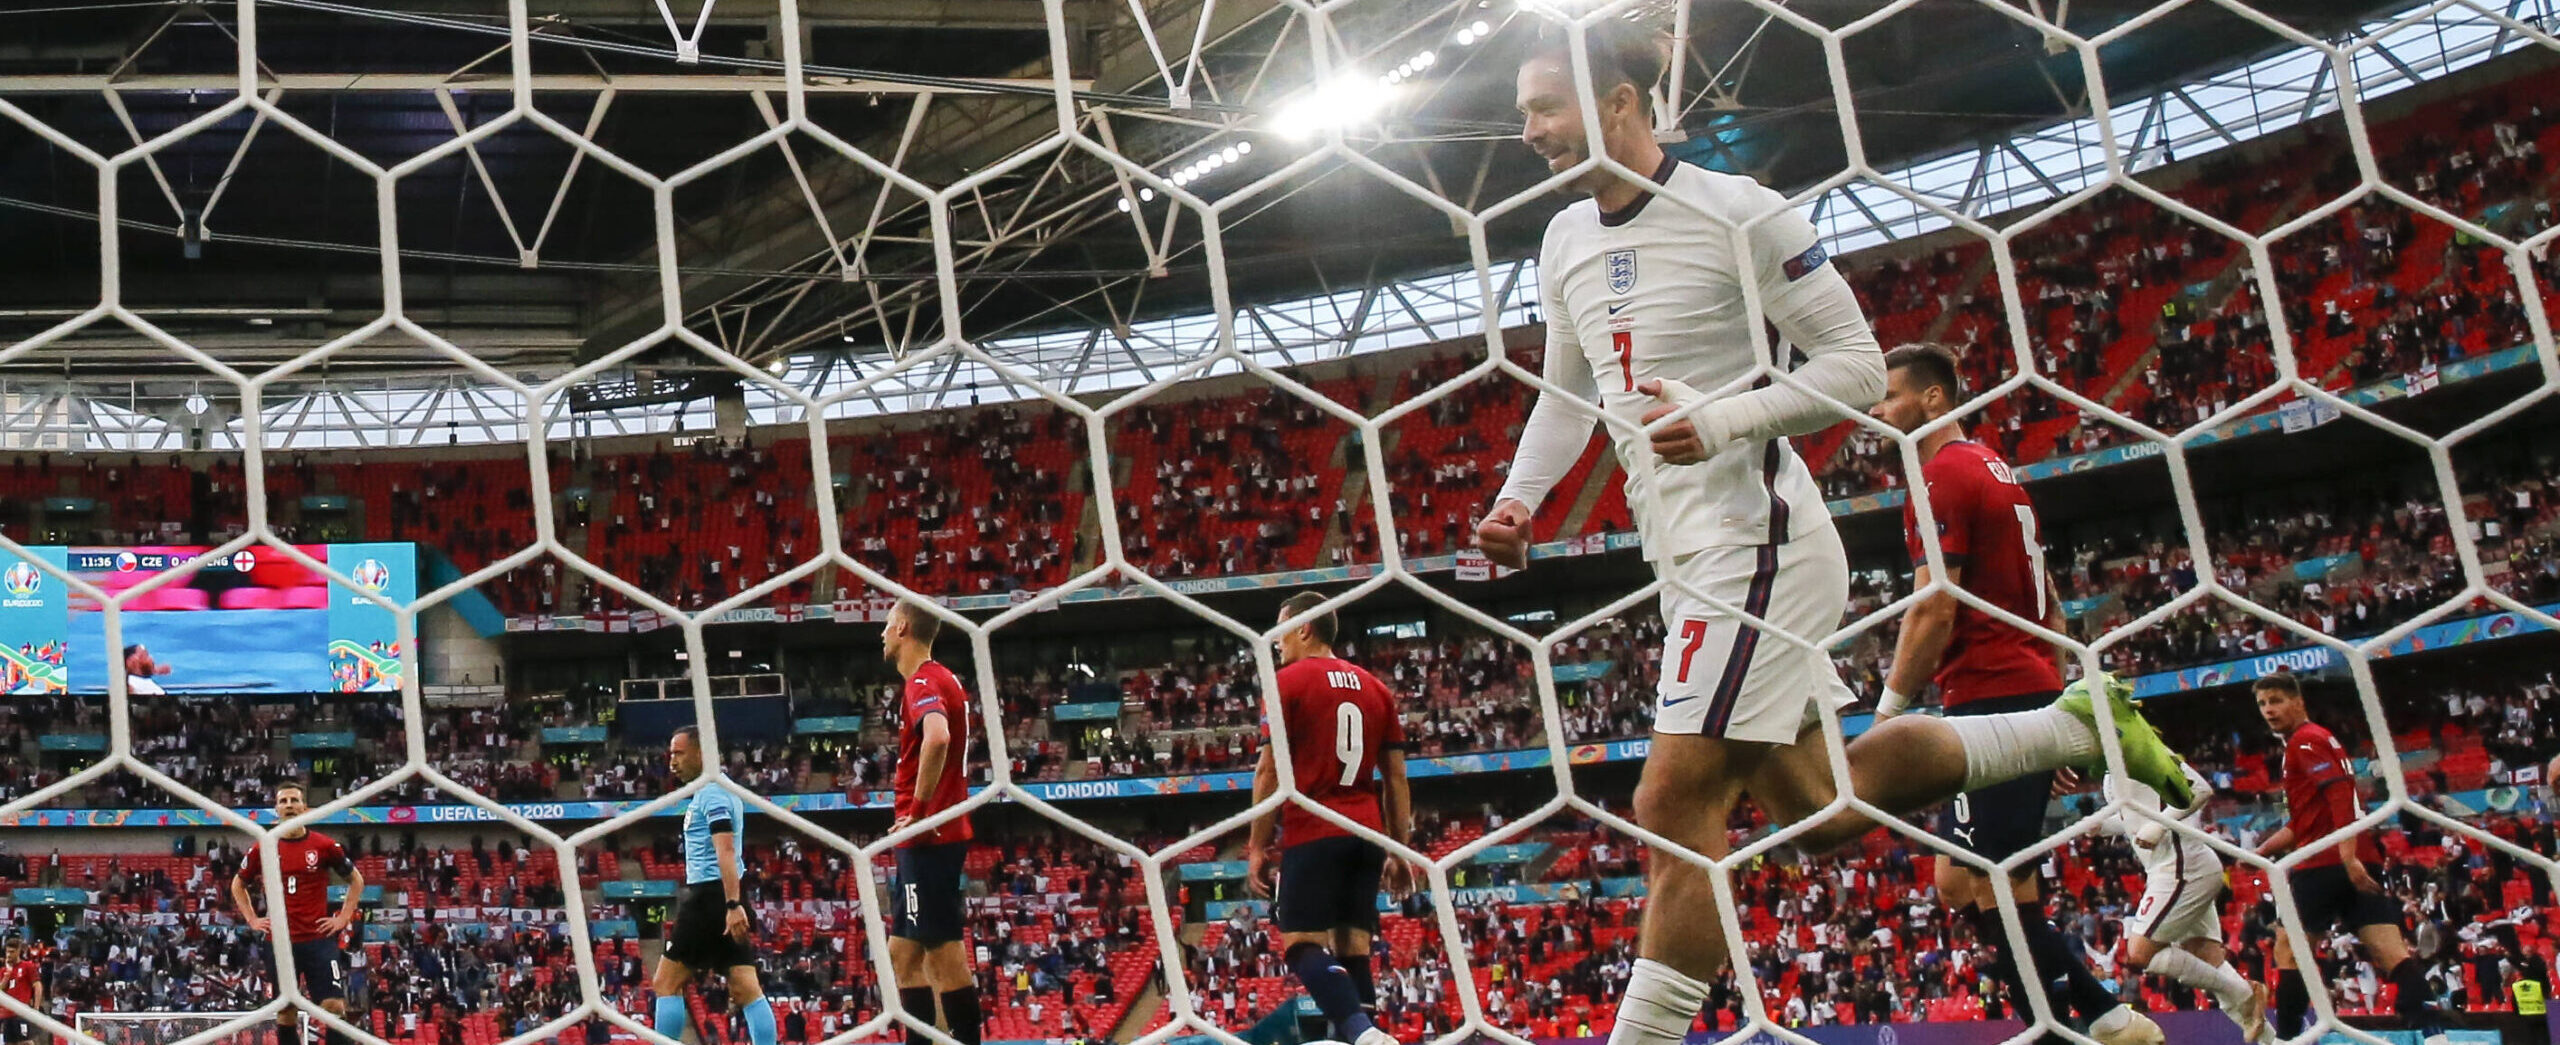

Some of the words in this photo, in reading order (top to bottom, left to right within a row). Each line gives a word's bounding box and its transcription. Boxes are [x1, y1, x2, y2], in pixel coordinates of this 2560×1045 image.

[1612, 331, 1634, 392] 7
[2121, 441, 2166, 460] LOND
[81, 556, 112, 567] 11:36
[141, 557, 163, 567] CZE
[1677, 619, 1708, 683] 7
[2255, 647, 2329, 677] LONDON
[1336, 701, 1363, 786] 9
[1045, 782, 1119, 799] LONDON
[432, 806, 474, 821] UEFA
[477, 806, 520, 820] EUO
[523, 804, 564, 819] 2020
[905, 883, 918, 913] 15
